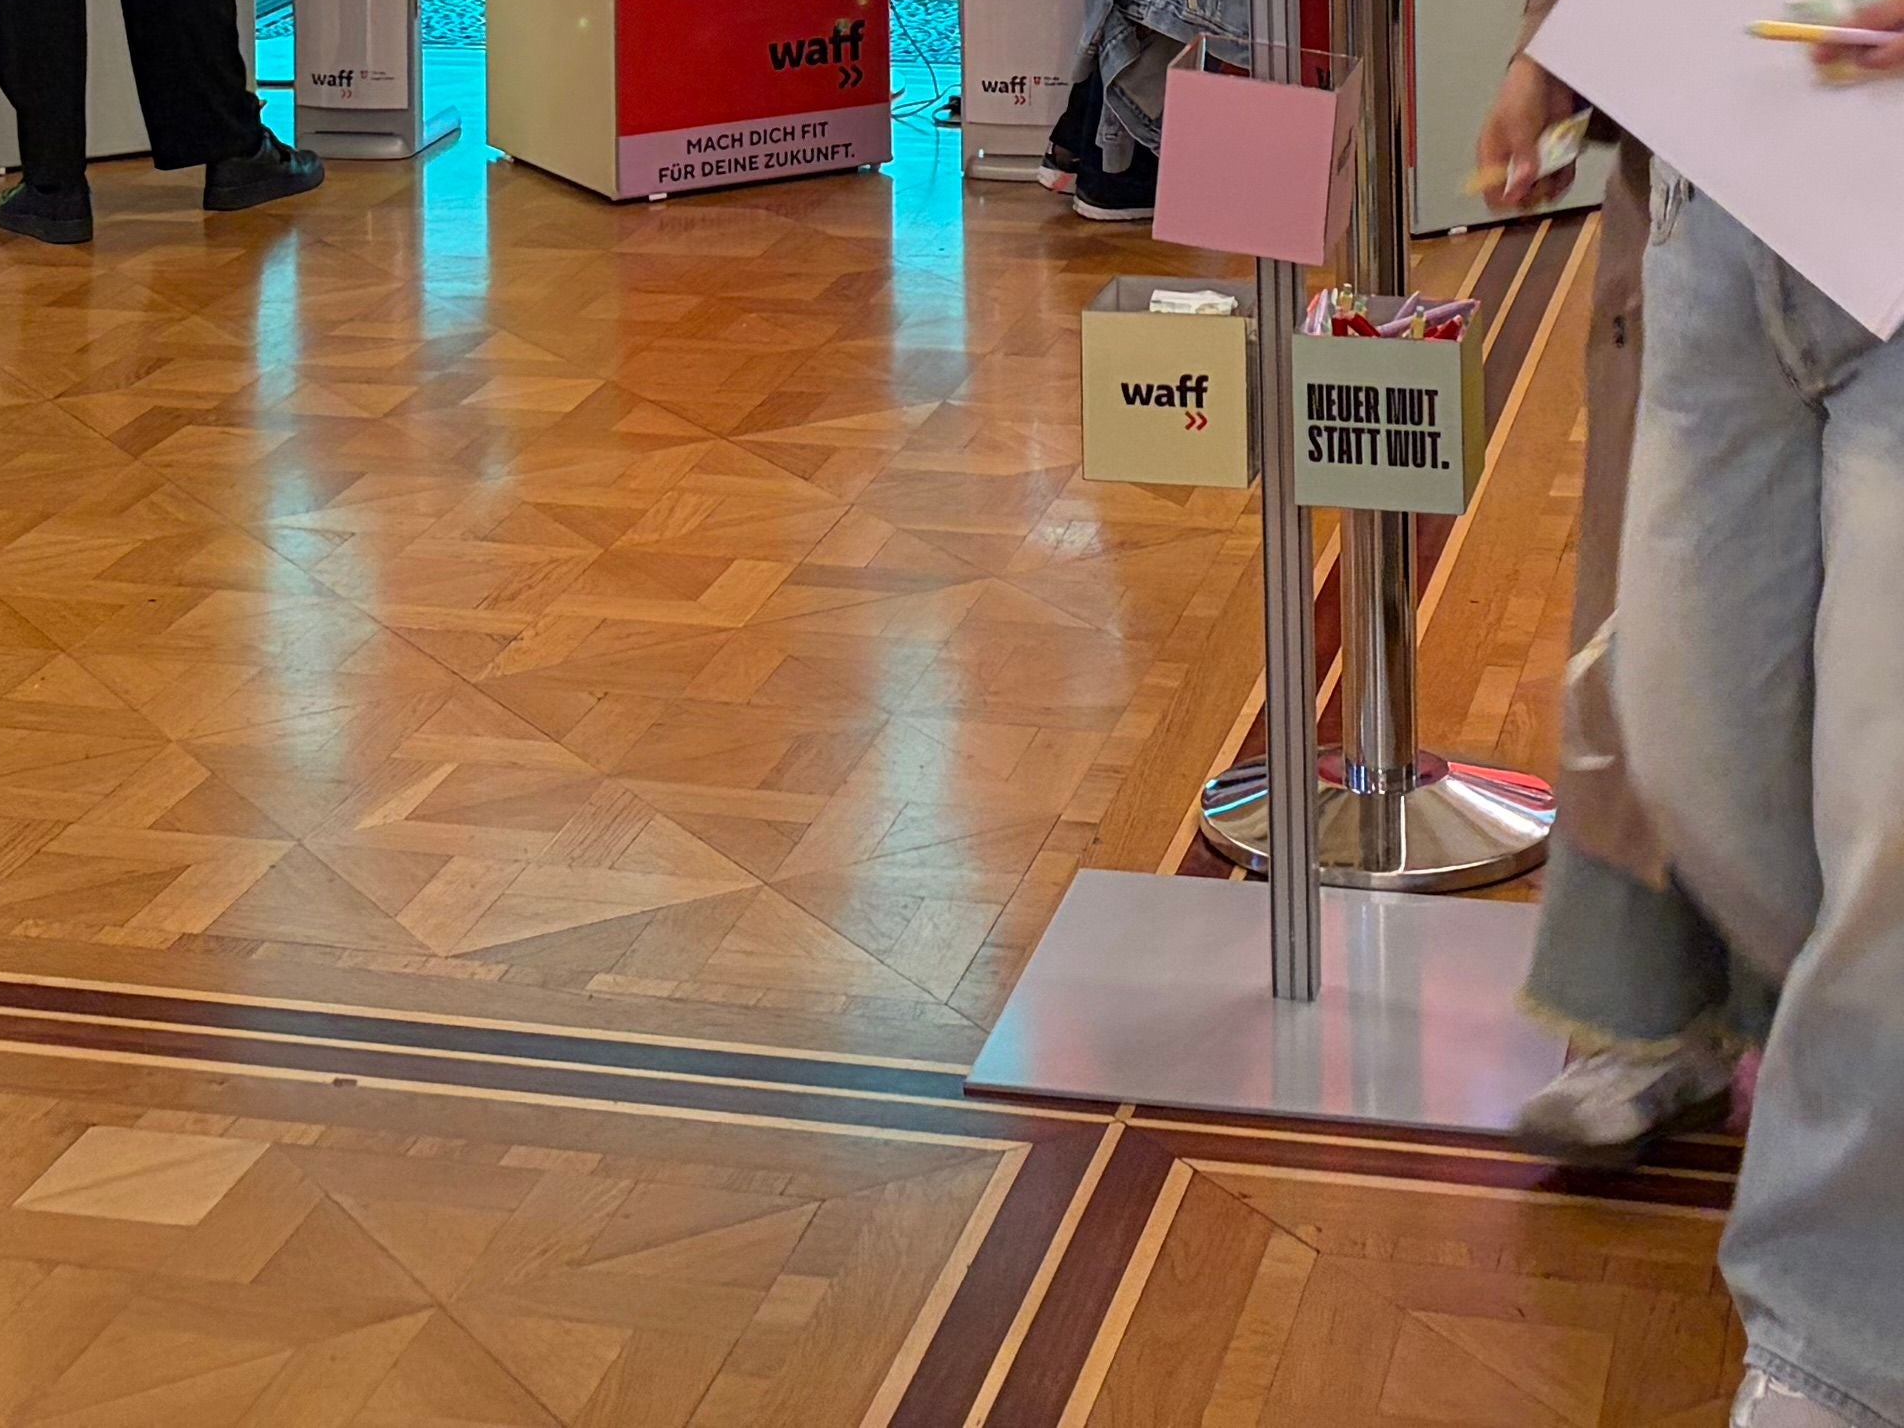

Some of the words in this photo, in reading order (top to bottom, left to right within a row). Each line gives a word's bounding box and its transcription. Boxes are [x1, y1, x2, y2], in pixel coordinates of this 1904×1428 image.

[769, 19, 865, 71] waff
[311, 69, 354, 87] waff
[982, 75, 1027, 94] waff
[686, 132, 744, 155] MACH
[749, 126, 795, 147] DICH
[801, 121, 829, 139] FIT
[658, 162, 695, 183] FÜR
[701, 155, 759, 177] DEINE
[764, 142, 856, 169] ZUKUNFT.
[1121, 374, 1209, 410] waff
[1306, 382, 1380, 426] NEUER
[1386, 386, 1439, 428] MUT
[1307, 424, 1379, 468] STATT
[1386, 427, 1451, 471] WUT.
